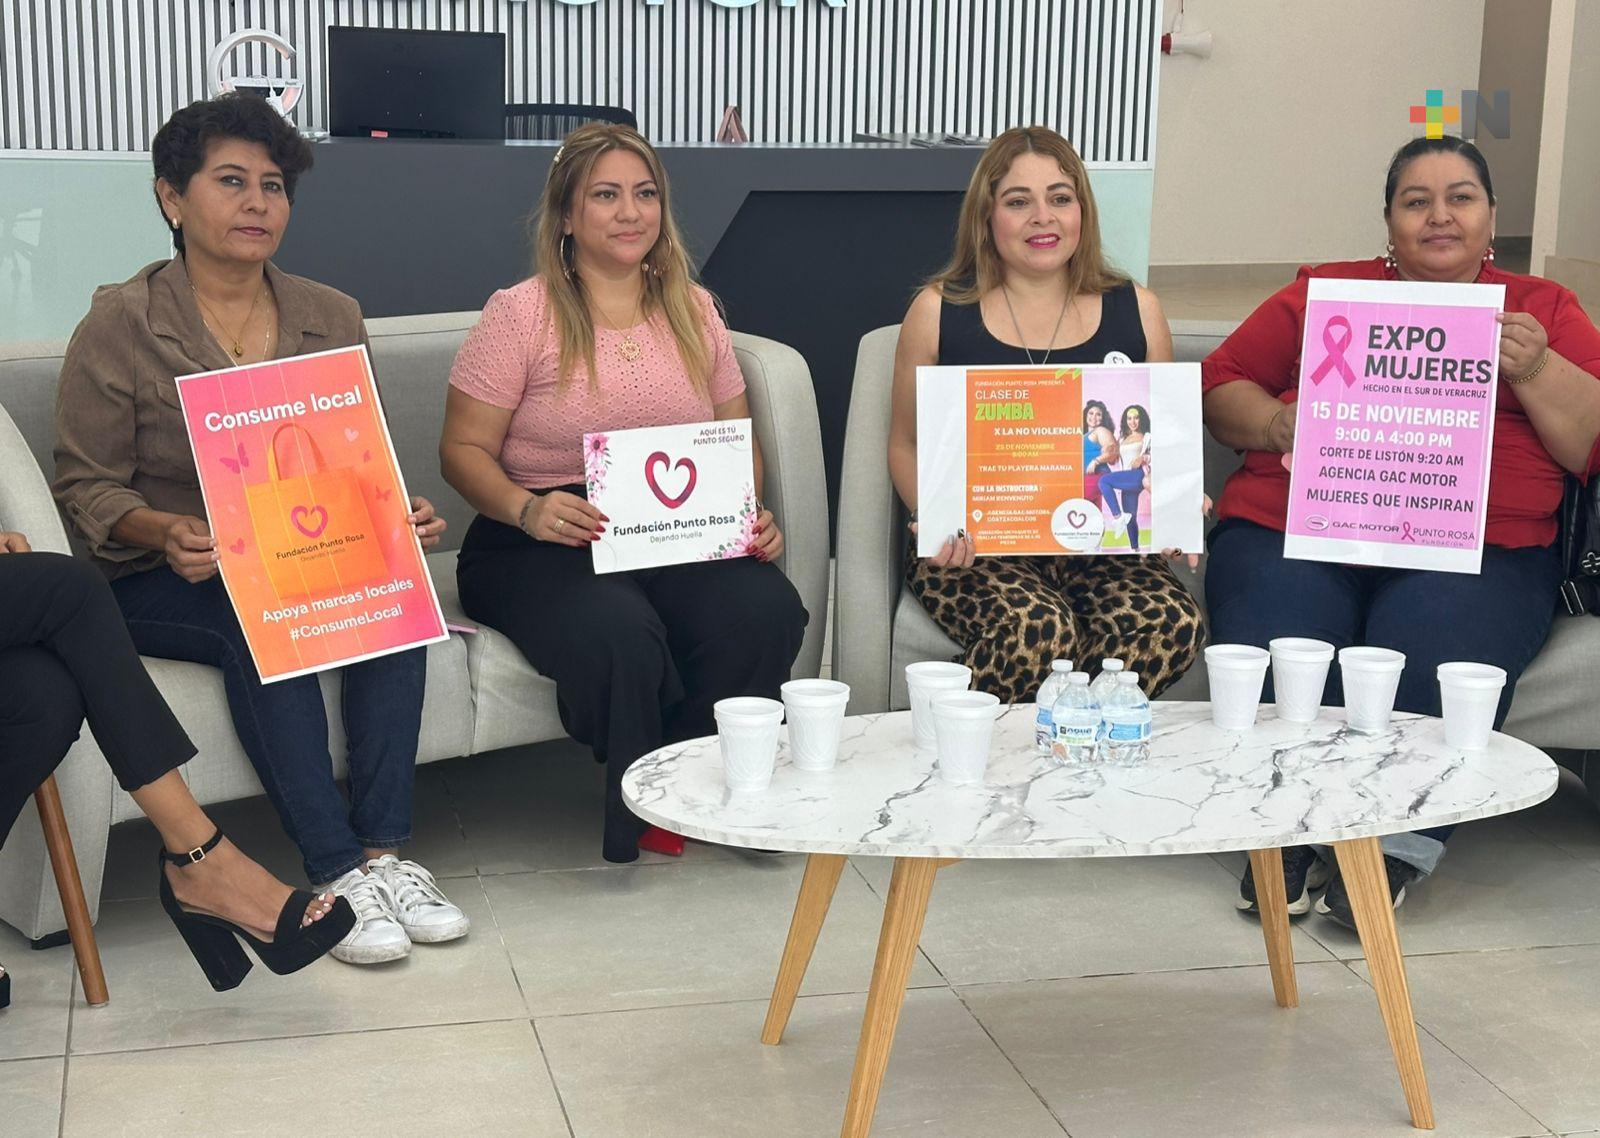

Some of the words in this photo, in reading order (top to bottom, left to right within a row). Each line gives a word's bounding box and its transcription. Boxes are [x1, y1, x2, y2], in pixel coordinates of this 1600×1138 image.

[1367, 324, 1446, 352] EXPO
[1363, 354, 1493, 384] MUJERES
[975, 390, 1012, 400] CLASE
[1014, 390, 1030, 399] DE
[1363, 384, 1390, 394] HECHO
[1391, 386, 1403, 394] EN
[1404, 386, 1414, 395] EL
[1414, 387, 1431, 396] SUR
[1432, 388, 1443, 396] DE
[1444, 388, 1487, 399] VERACRUZ
[204, 401, 306, 432] Consume
[310, 384, 363, 412] local
[975, 402, 1034, 421] ZUMBA
[1310, 401, 1331, 420] 15
[1336, 403, 1360, 421] DE
[1366, 404, 1480, 429] NOVIEMBRE
[693, 437, 717, 446] PUNTO
[718, 434, 745, 444] SEGURO
[700, 427, 717, 436] AQUÍ
[727, 425, 736, 434] TÚ
[994, 428, 1001, 436] X
[1002, 428, 1014, 436] LA
[1015, 428, 1030, 436] NO
[1032, 427, 1083, 436] VIOLENCIA
[1335, 427, 1368, 442] 9:00
[1374, 430, 1385, 443] A
[1390, 430, 1425, 446] 4:00
[1428, 432, 1452, 448] PM
[1319, 446, 1355, 460] CORTE
[1358, 448, 1373, 461] DE
[1374, 448, 1414, 464] LISTÓN
[1417, 453, 1443, 465] 9:20
[1445, 454, 1464, 466] AM
[1040, 464, 1073, 472] NARANJA
[1318, 466, 1376, 482] AGENCIA
[1379, 470, 1407, 484] GAC
[1410, 472, 1458, 488] MOTOR
[972, 485, 986, 493] CON
[995, 484, 1038, 493] INSTRUCTORA
[1306, 488, 1369, 506] MUJERES
[1372, 492, 1401, 508] QUE
[1405, 495, 1474, 514] INSPIRAN
[612, 520, 672, 537] Fundación
[673, 518, 708, 531] Punto
[708, 514, 736, 526] Rosa
[1332, 521, 1358, 530] GAC
[1358, 523, 1400, 533] MOTOR
[1412, 527, 1447, 538] PUNTO
[1448, 530, 1475, 541] ROSA
[276, 544, 318, 560] Fundación
[320, 538, 344, 550] Punto
[344, 533, 365, 544] Rosa
[649, 532, 680, 544] Dejando
[680, 530, 703, 540] Huella
[261, 600, 310, 624] Apoya
[311, 590, 364, 610] marcas
[365, 576, 414, 599] locales
[290, 604, 404, 641] #ConsumeLocal
